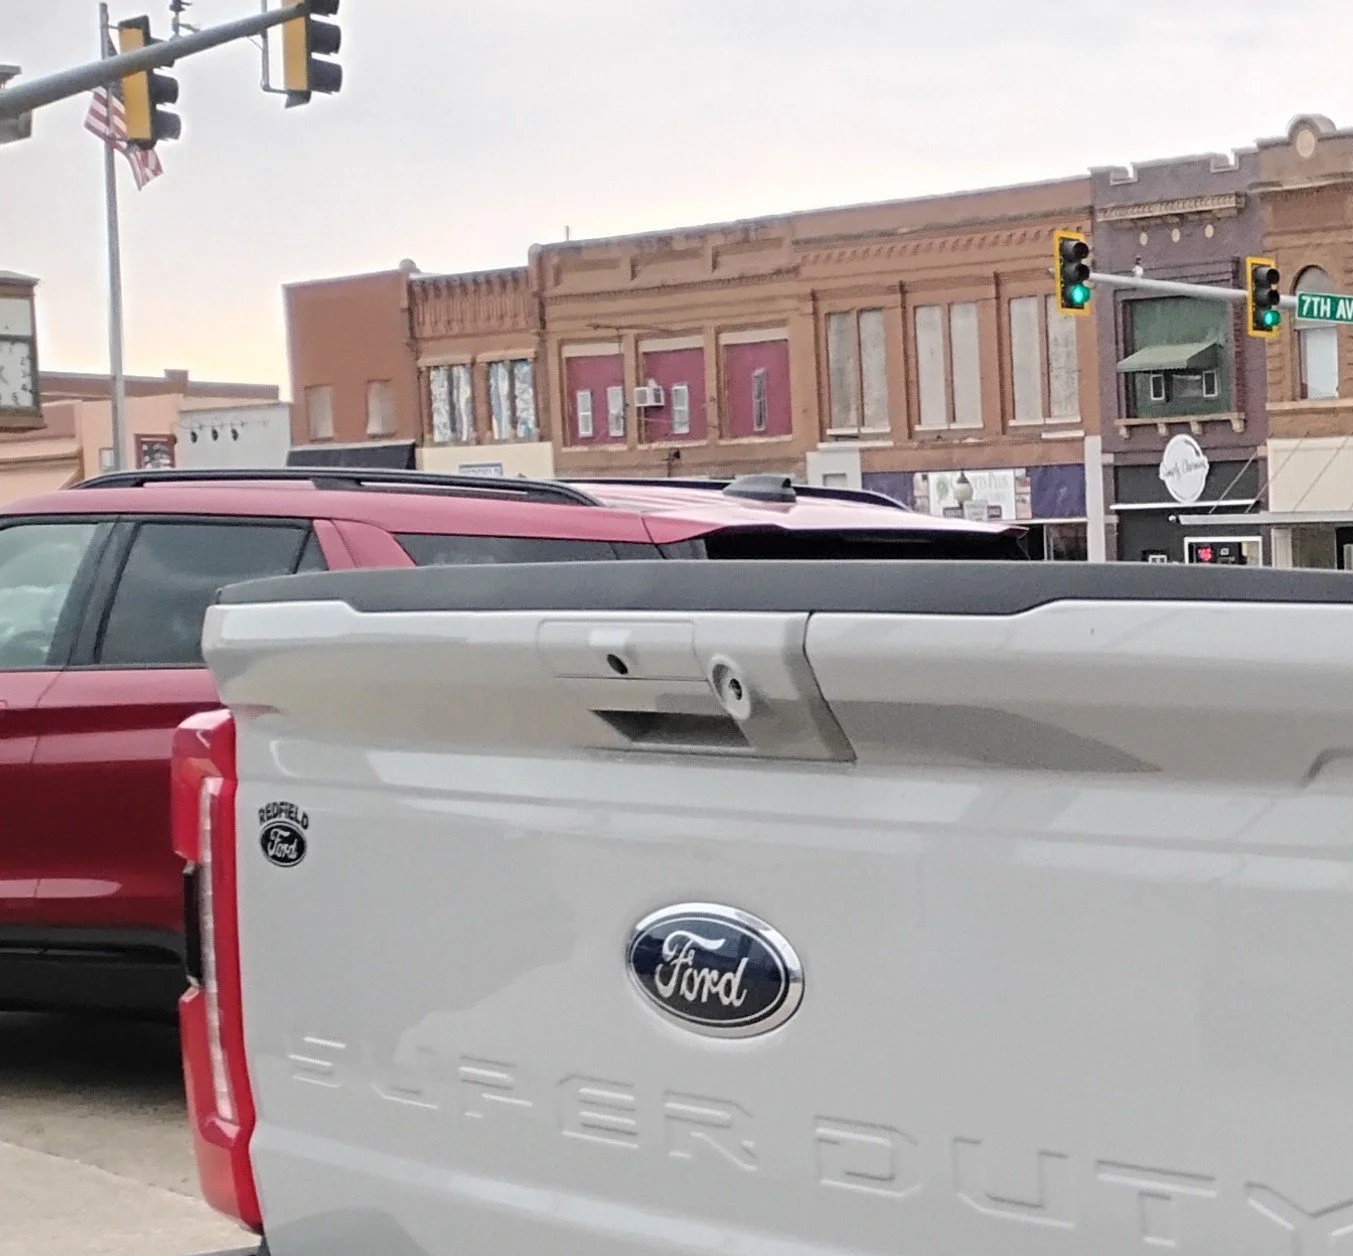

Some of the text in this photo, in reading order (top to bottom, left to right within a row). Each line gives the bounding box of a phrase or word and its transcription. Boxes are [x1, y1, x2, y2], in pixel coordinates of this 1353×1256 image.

[1301, 295, 1331, 318] 7TH
[258, 801, 309, 830] REDFIELD
[267, 828, 298, 859] Ford
[654, 930, 749, 1007] Ford
